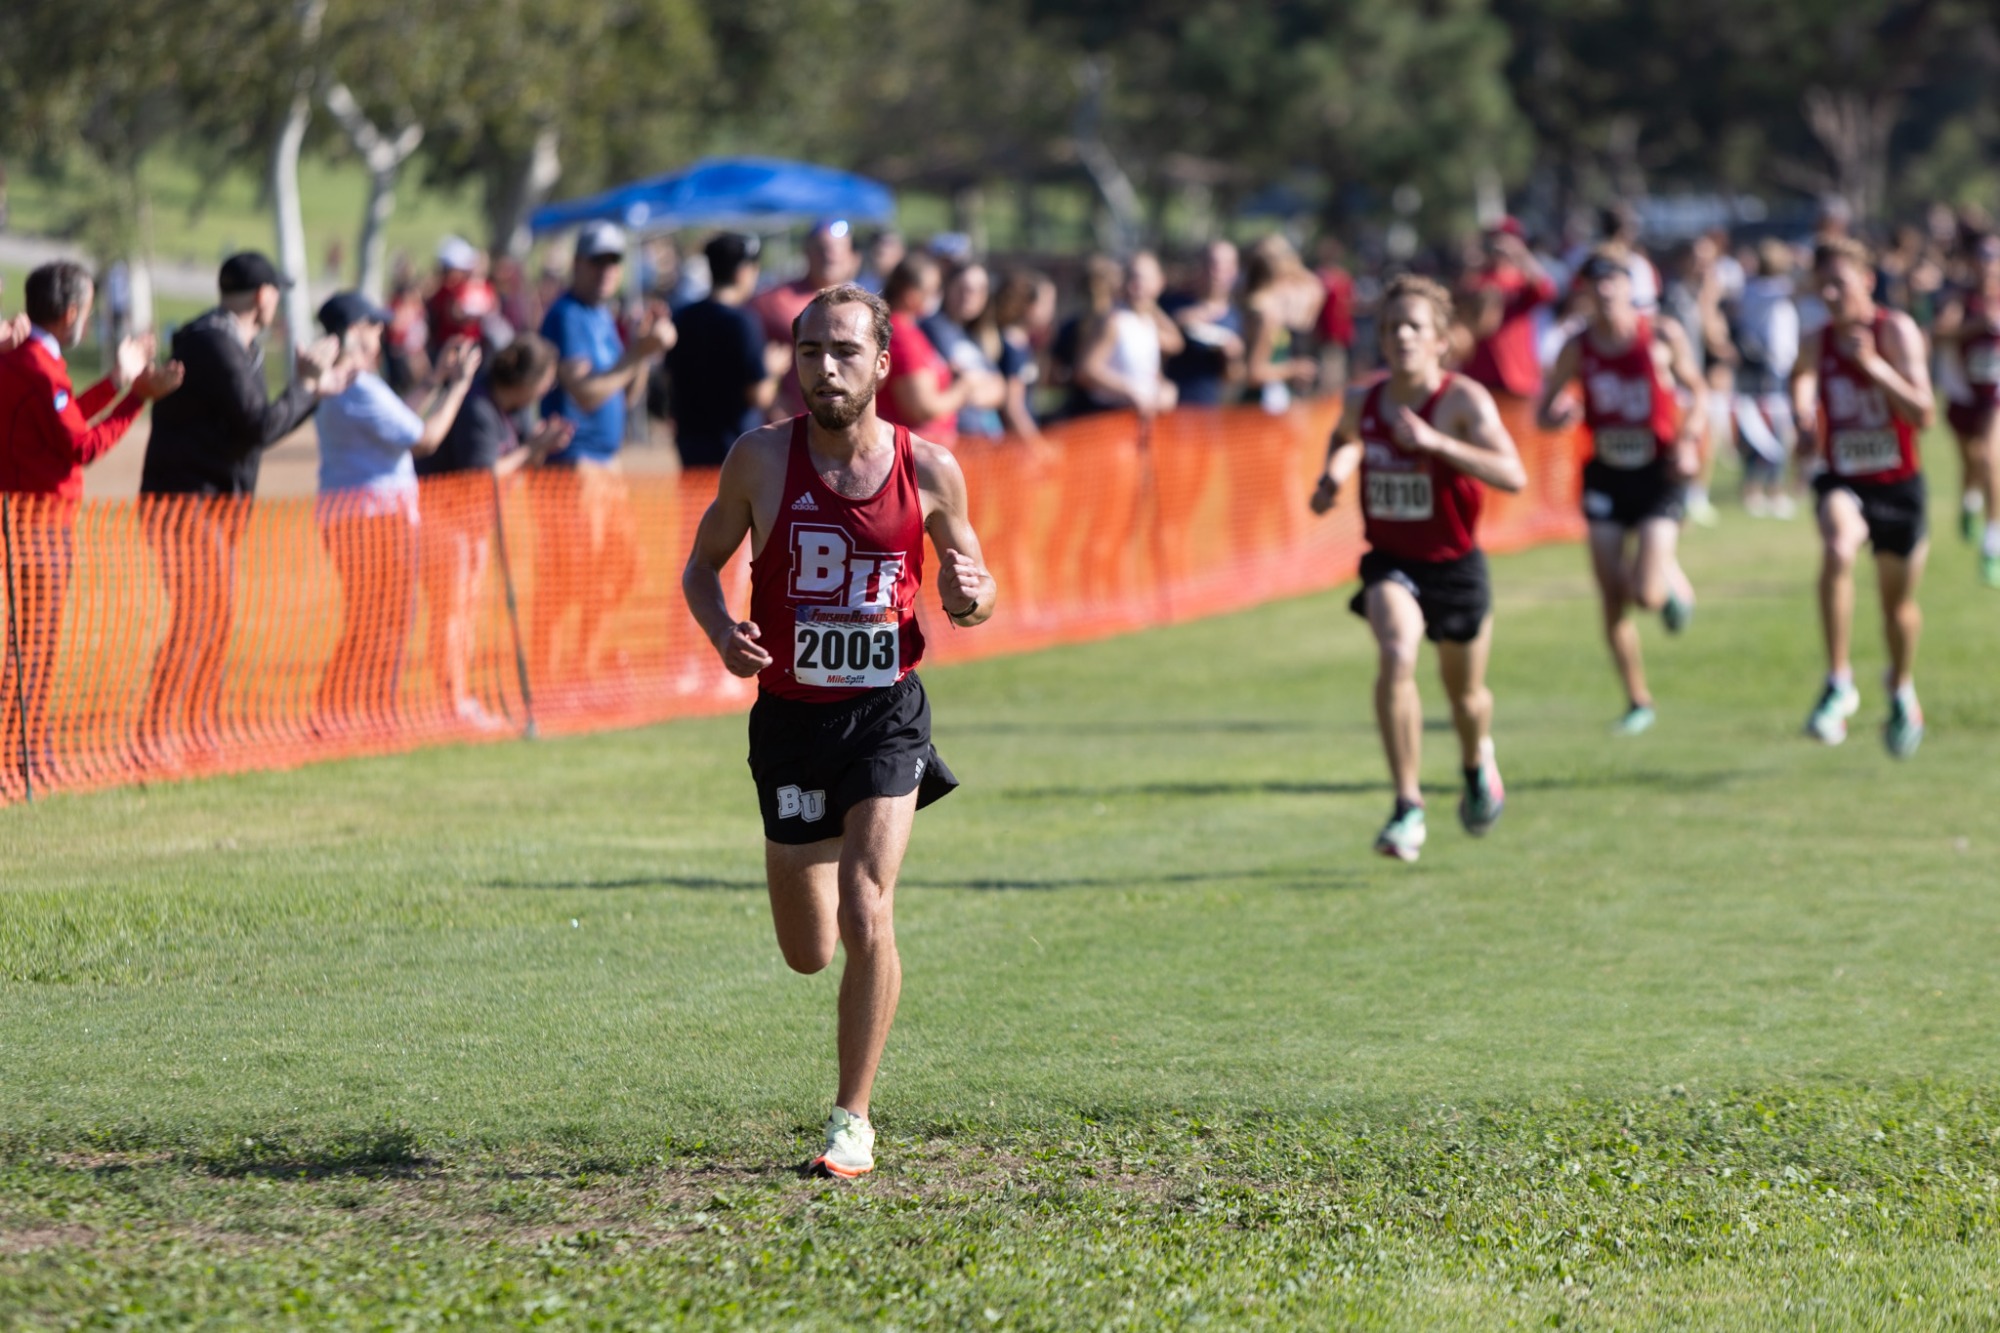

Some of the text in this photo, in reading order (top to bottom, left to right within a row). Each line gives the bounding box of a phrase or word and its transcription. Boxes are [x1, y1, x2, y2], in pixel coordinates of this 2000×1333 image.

[791, 503, 819, 511] adidas
[787, 522, 907, 607] BU
[796, 629, 894, 670] 2003
[826, 675, 865, 685] MileSplit
[777, 784, 826, 823] BU
